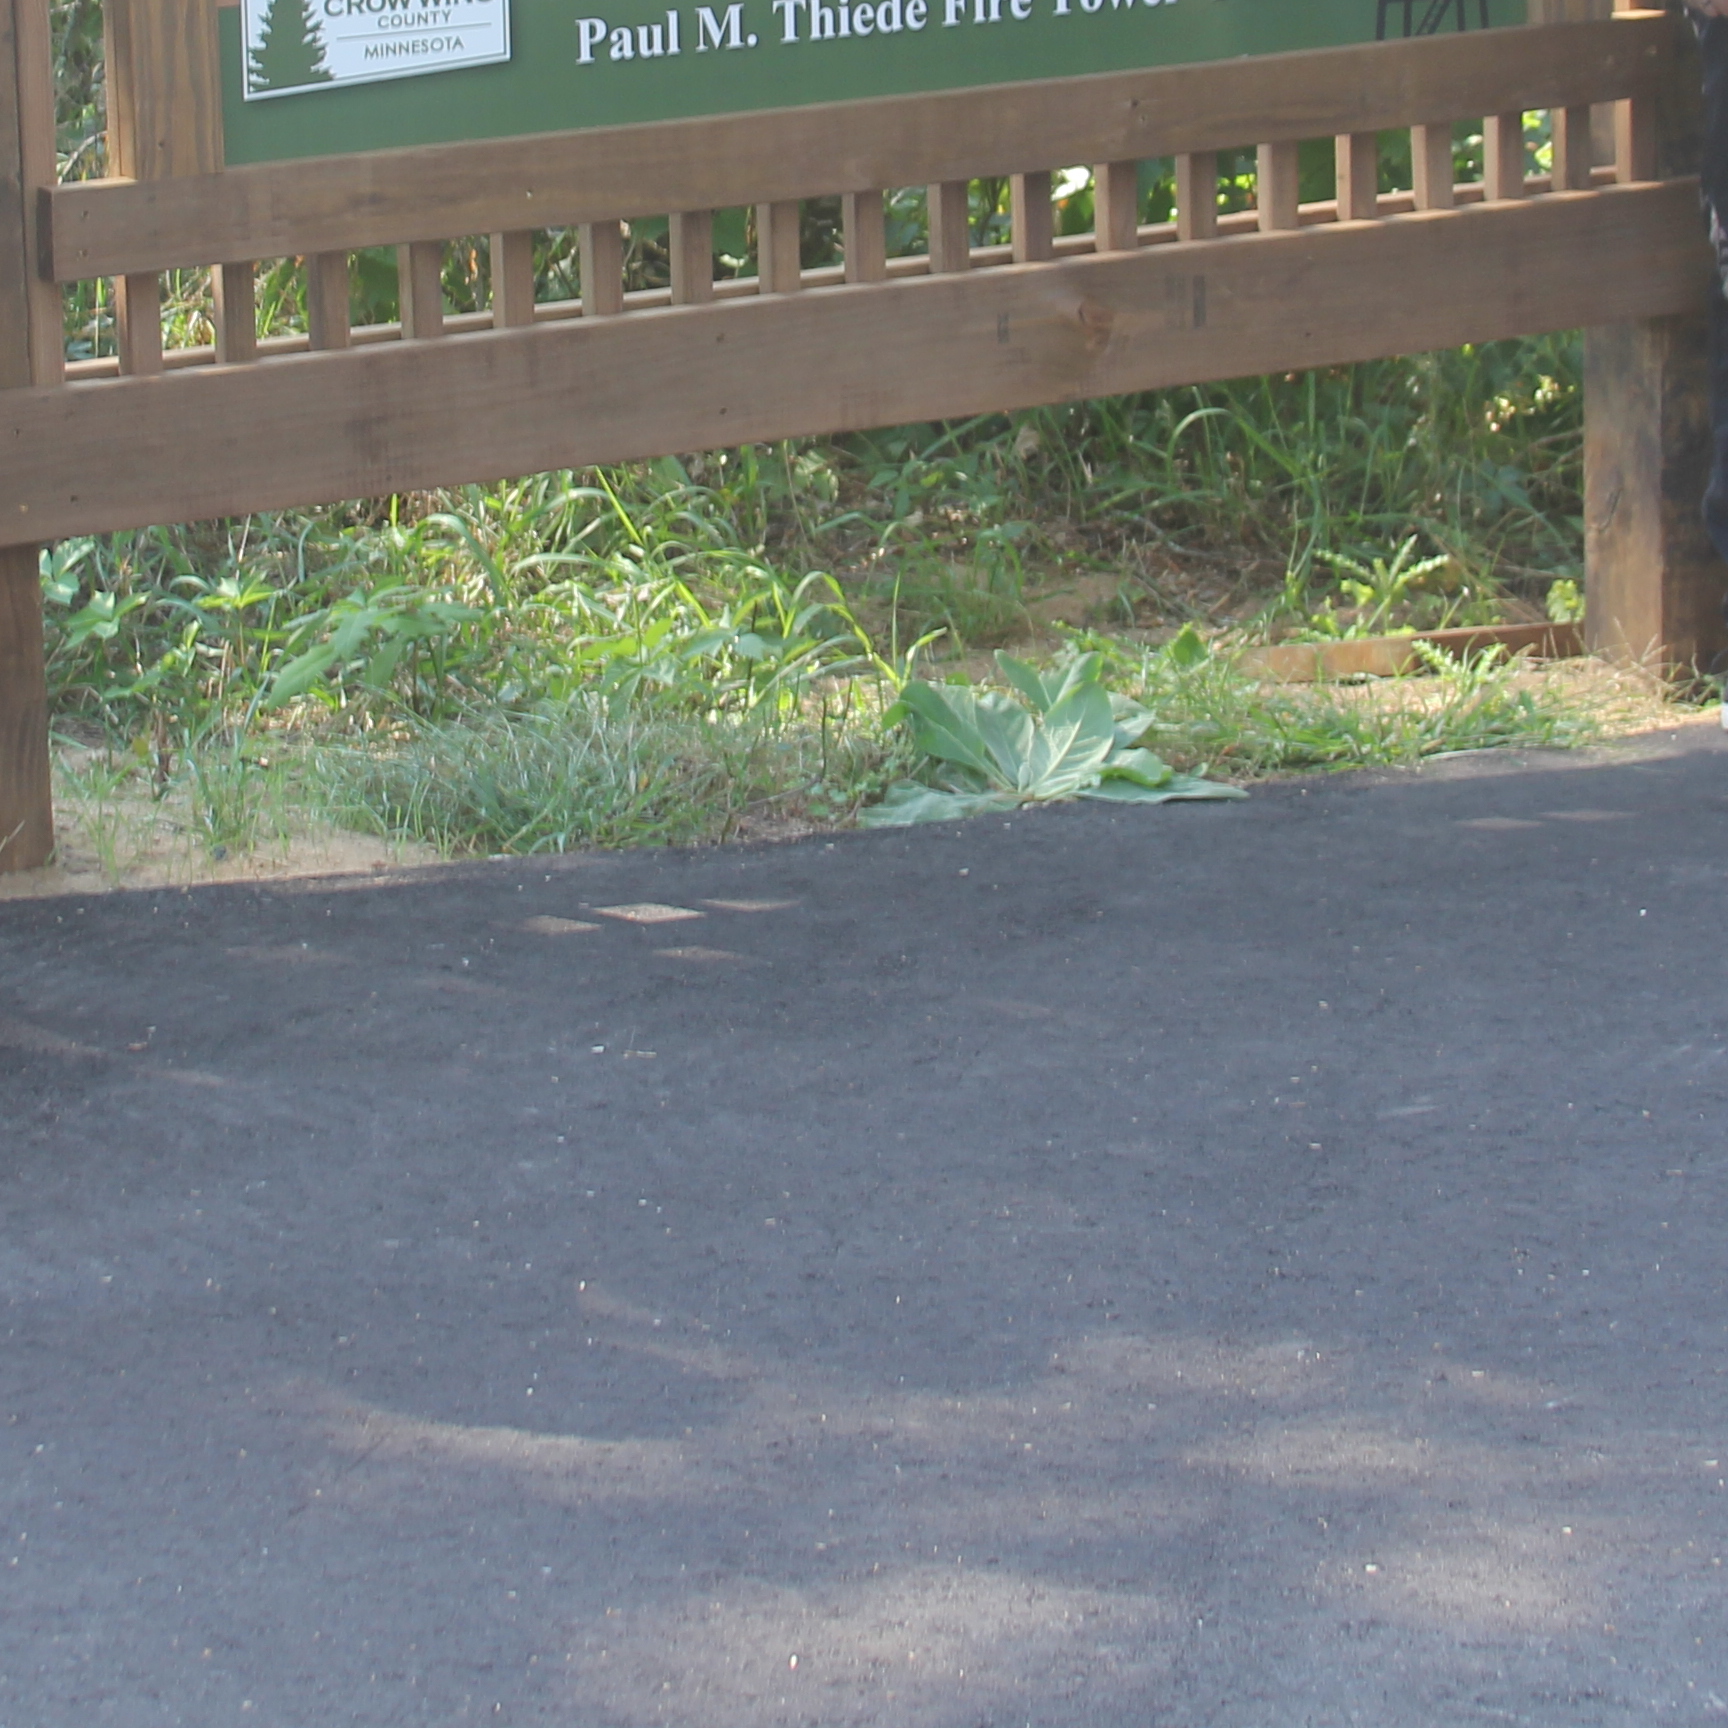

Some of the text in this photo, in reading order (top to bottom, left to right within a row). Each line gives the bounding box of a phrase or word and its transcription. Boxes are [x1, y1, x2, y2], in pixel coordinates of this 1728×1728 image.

[375, 5, 451, 29] COUNTY
[574, 10, 681, 63] Paul
[693, 3, 757, 52] M.
[364, 36, 464, 59] MINNESOTA
